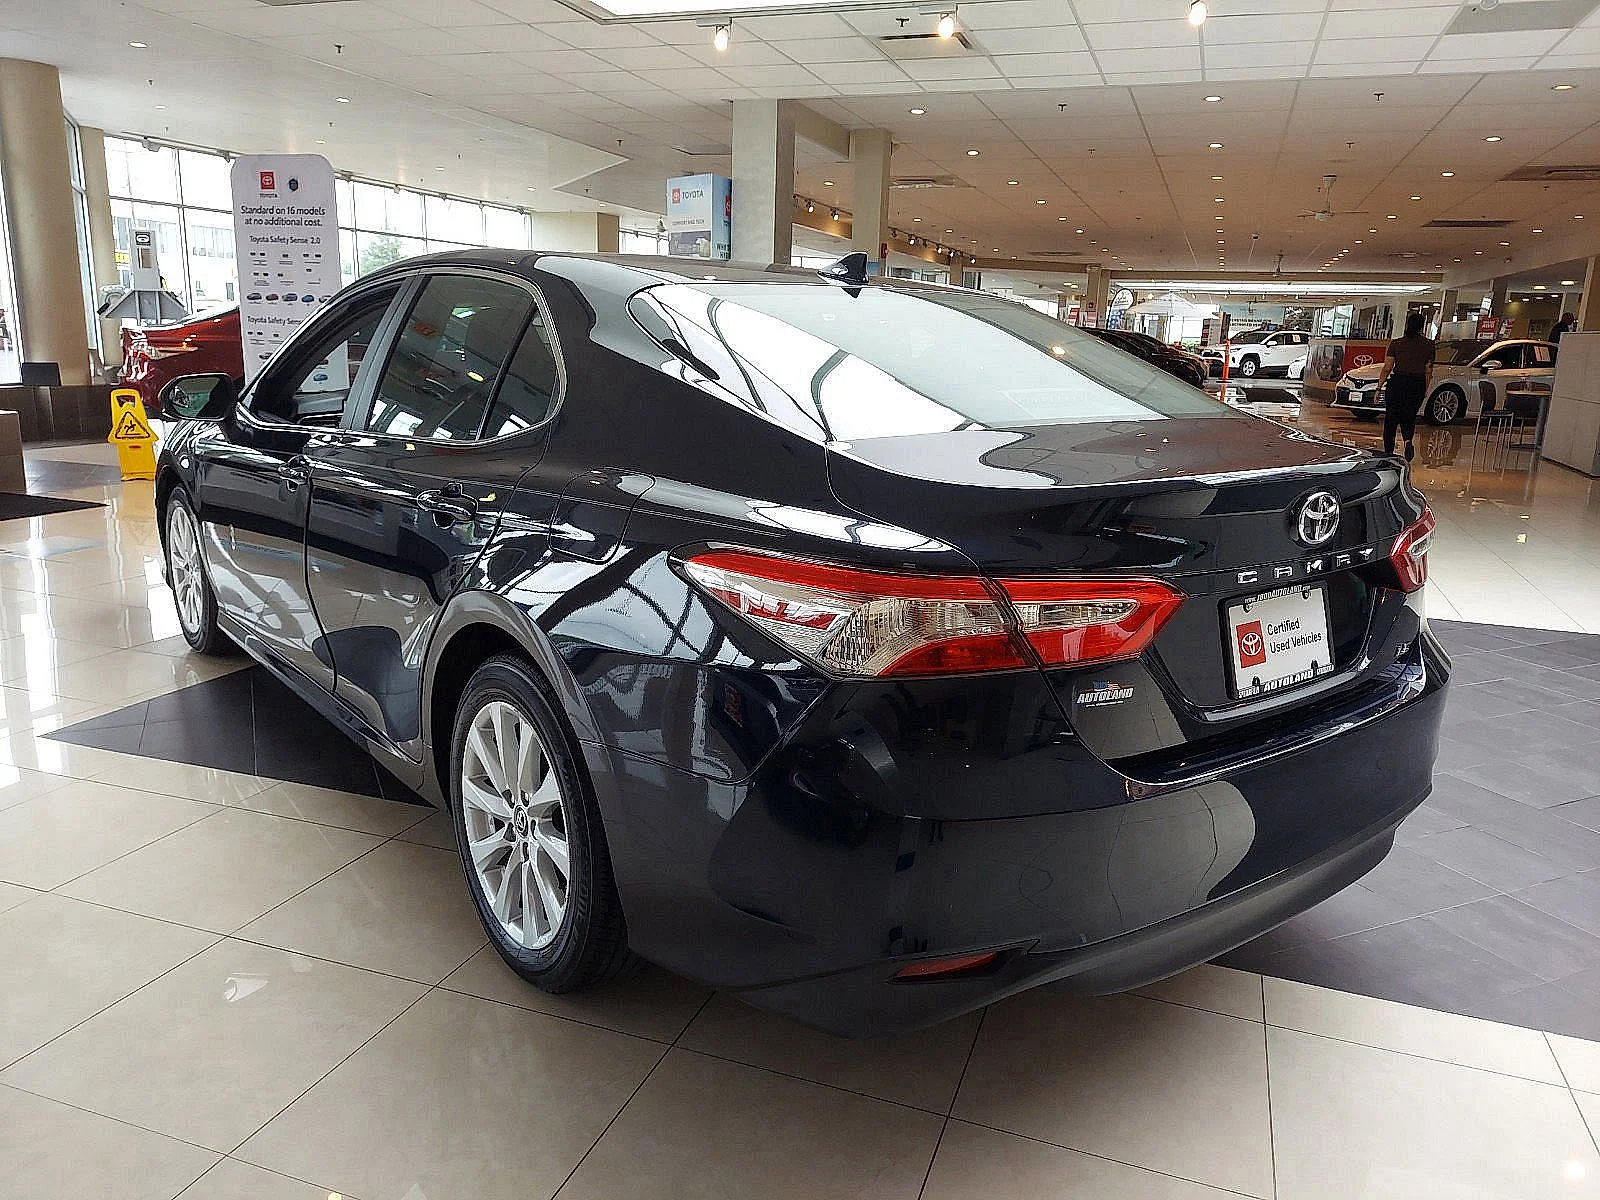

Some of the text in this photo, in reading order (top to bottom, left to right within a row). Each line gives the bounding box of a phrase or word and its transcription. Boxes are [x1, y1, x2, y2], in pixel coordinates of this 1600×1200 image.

[682, 190, 704, 199] TOYOTA
[241, 205, 274, 215] Standard
[287, 206, 296, 215] 16
[297, 206, 326, 216] models
[245, 217, 252, 225] at
[264, 216, 302, 226] additional
[304, 218, 323, 226] cost.
[249, 235, 269, 244] Toyota
[270, 236, 289, 245] Safety
[247, 315, 267, 325] Toyota
[267, 316, 286, 326] Safety
[1237, 548, 1373, 584] CAMRY
[1267, 617, 1300, 636] Certified
[1270, 631, 1321, 654] Used Vehicles
[1263, 669, 1314, 692] AUTOLAND
[1076, 688, 1134, 704] AUTOLAND
